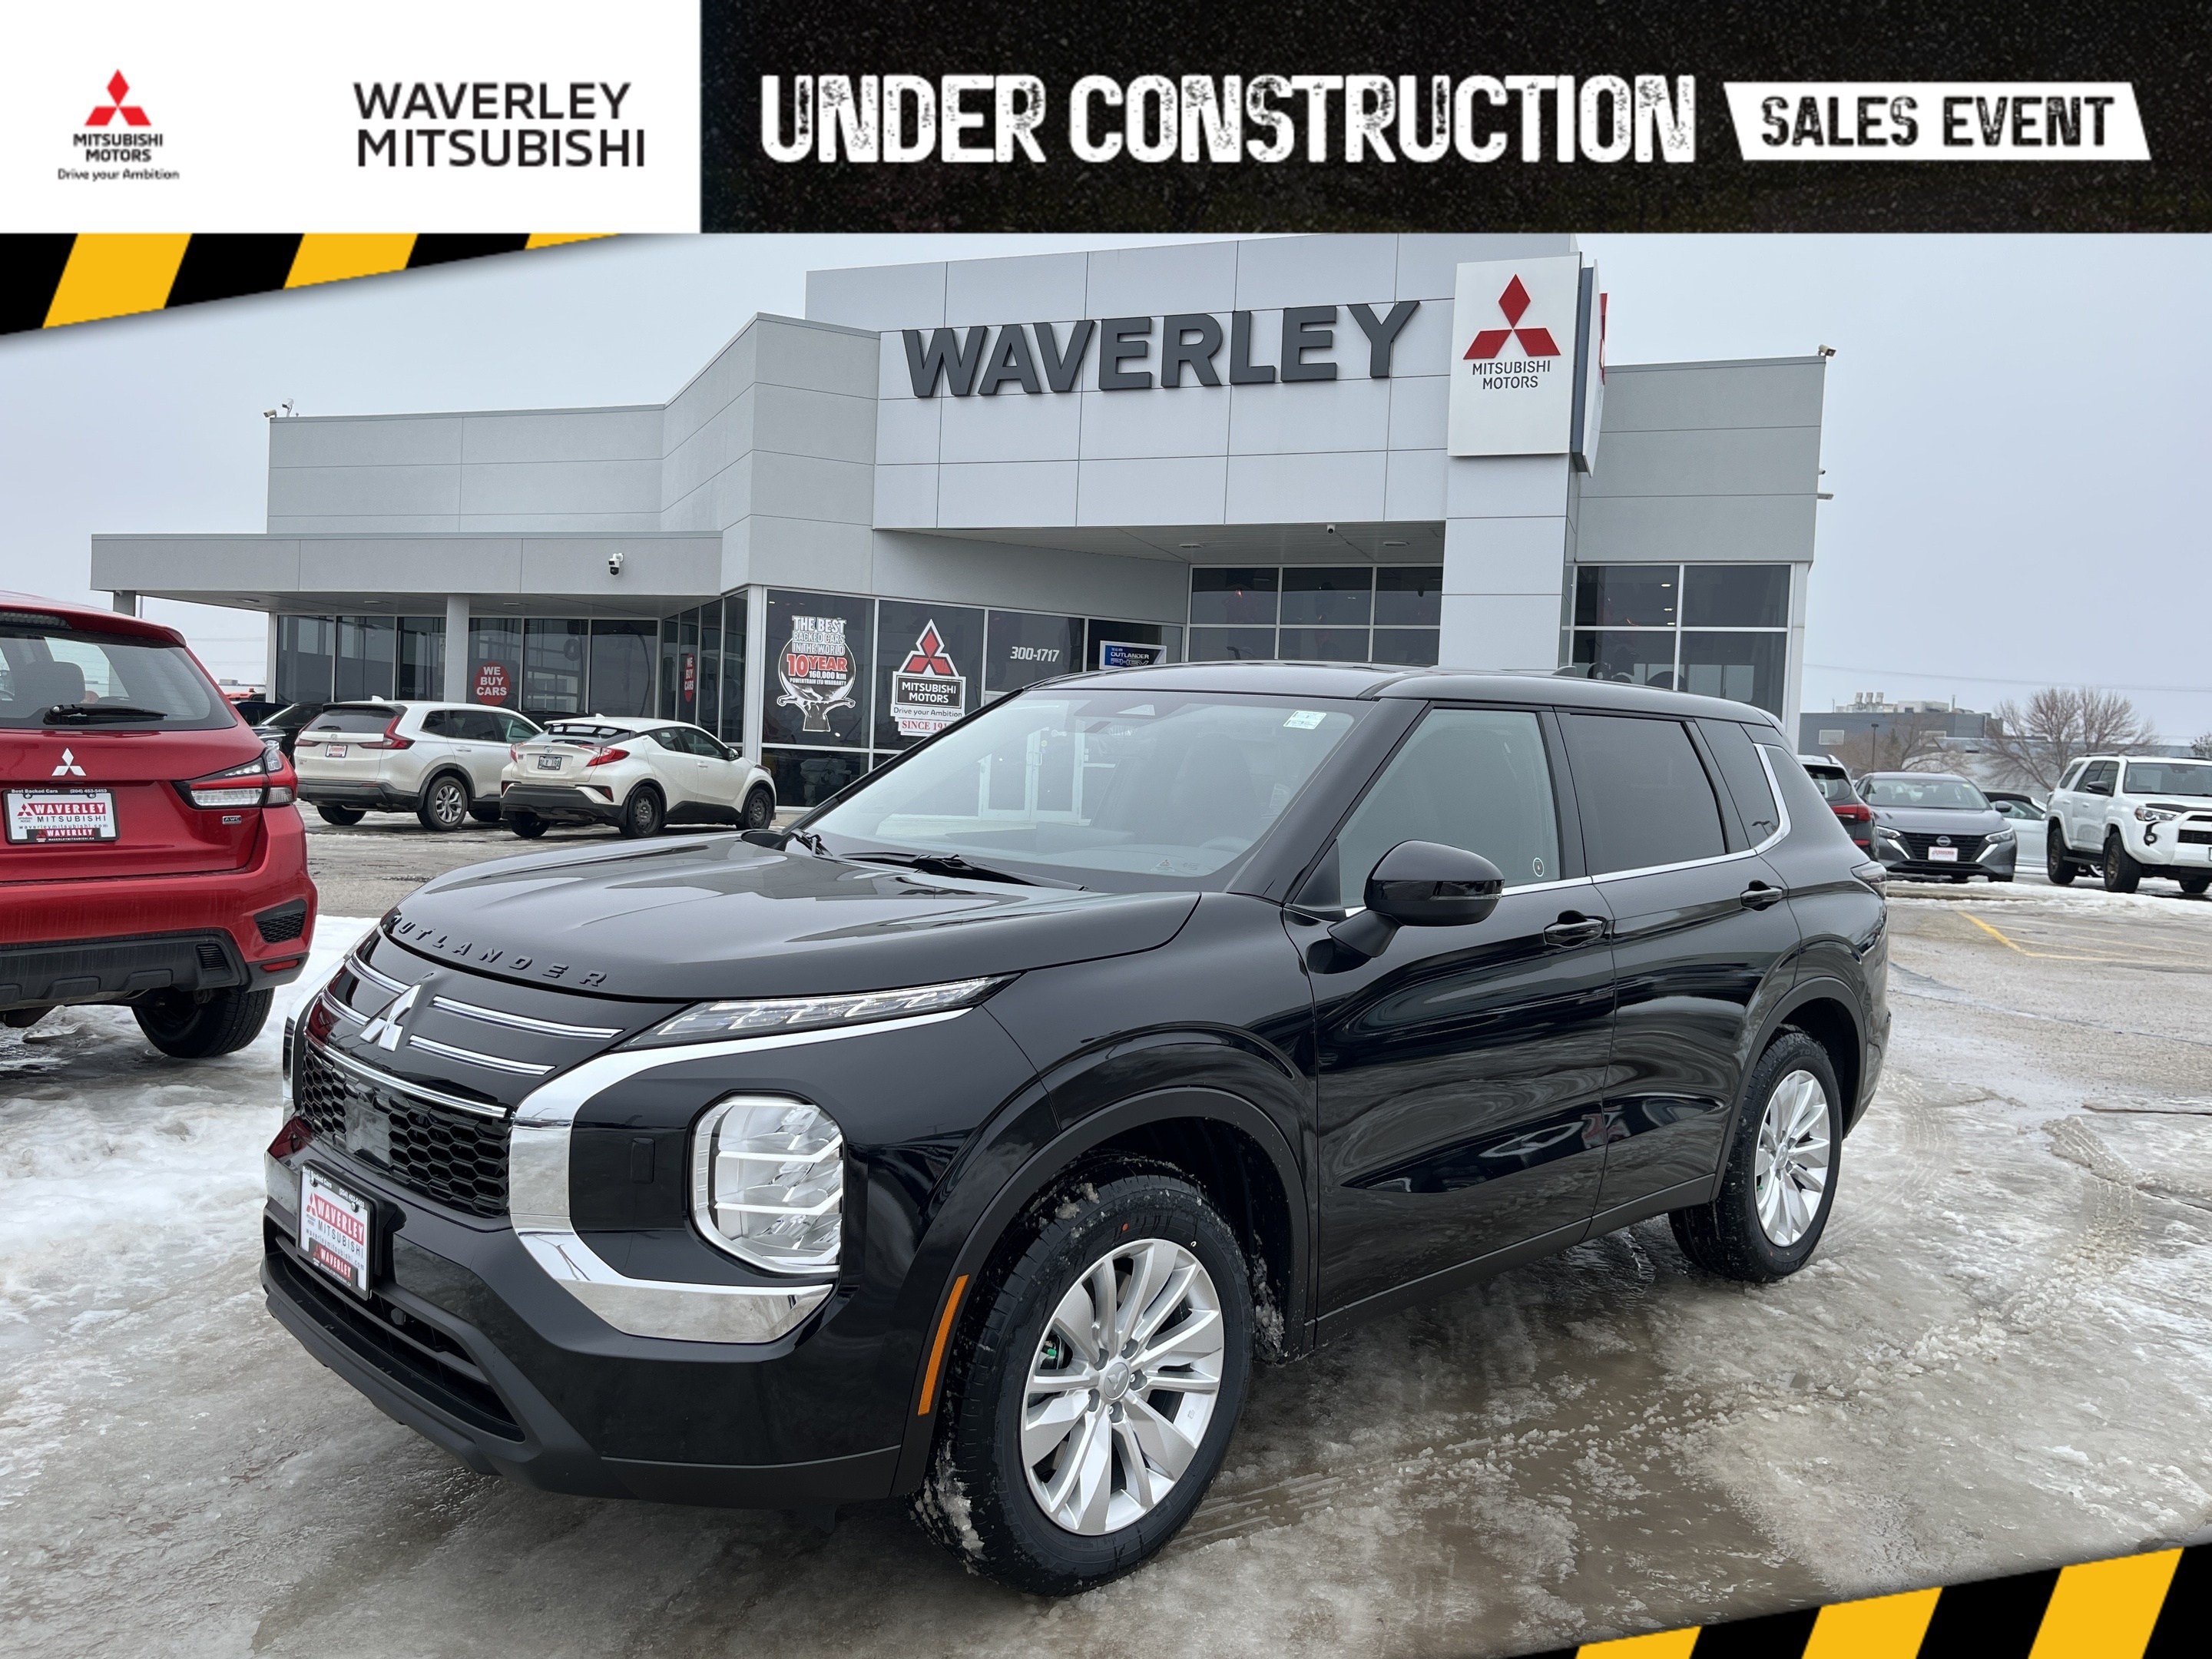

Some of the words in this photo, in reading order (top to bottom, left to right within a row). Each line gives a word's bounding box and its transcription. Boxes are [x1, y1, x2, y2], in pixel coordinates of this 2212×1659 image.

[902, 300, 1421, 399] WAVERLEY
[1472, 359, 1551, 376] MITSUBISHI
[1482, 376, 1539, 390] MOTORS
[793, 616, 816, 631] THE
[816, 618, 846, 634] BEST
[793, 631, 823, 643] BACKED
[824, 634, 846, 644] CARS
[793, 642, 802, 653] IN
[801, 642, 817, 654] THE
[817, 644, 845, 655] WORLD
[1010, 646, 1060, 662] 300-1717
[1110, 651, 1150, 660] OUTLANDER
[786, 654, 810, 677] 10
[807, 655, 848, 672] YEAR
[1110, 658, 1150, 667] PHEV
[482, 666, 502, 676] WE
[809, 671, 836, 680] 160,000
[479, 677, 505, 686] BUY
[684, 680, 694, 691] CARS
[902, 681, 956, 694] MITSUBISHI
[476, 687, 508, 696] CARS
[909, 692, 949, 704] MOTORS
[930, 709, 962, 718] Ambition
[902, 720, 931, 730] SINCE
[933, 722, 948, 731] 191
[34, 803, 104, 814] WAVERLEY
[389, 914, 608, 988] OUTLANDER
[317, 1199, 365, 1242] WAVERLEY
[318, 1219, 364, 1259] MITSUBISHI
[306, 1229, 365, 1271] waverleymitsubishi.com
[320, 1247, 352, 1278] WAVERLEY
